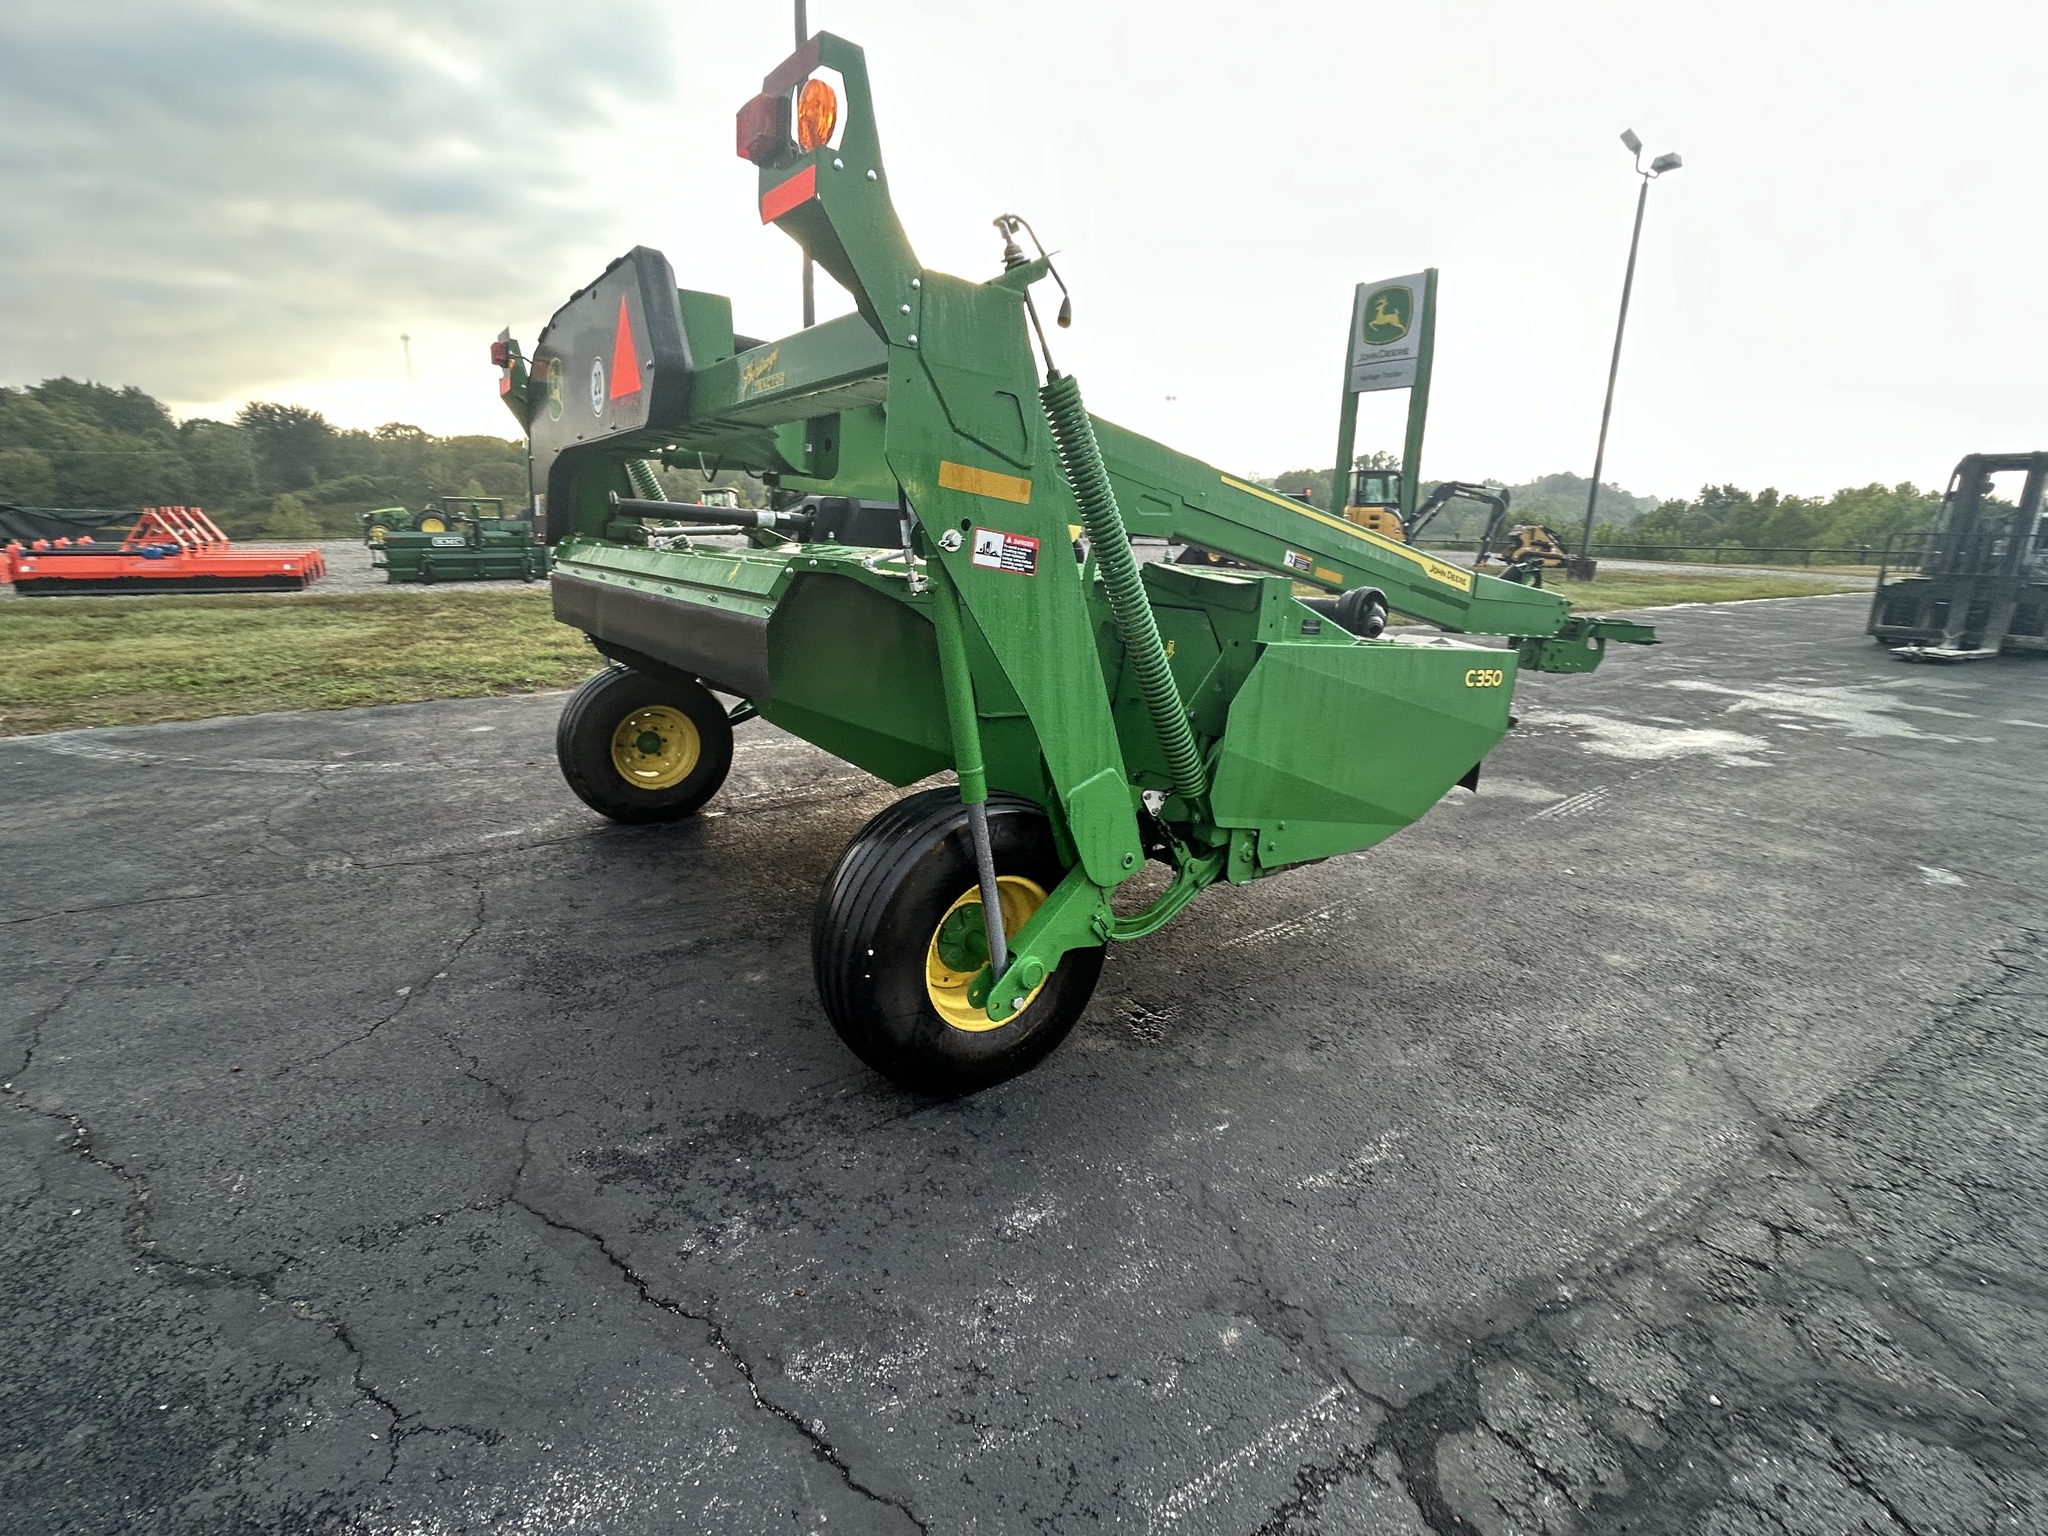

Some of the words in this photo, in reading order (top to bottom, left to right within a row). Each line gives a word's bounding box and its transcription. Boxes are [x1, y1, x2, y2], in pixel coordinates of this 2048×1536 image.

[1358, 352, 1380, 362] JOHN
[1380, 347, 1410, 358] DEERE
[594, 370, 602, 396] 20
[1429, 564, 1447, 578] JOHN
[1447, 570, 1467, 586] DEERE
[1465, 669, 1502, 687] C350
